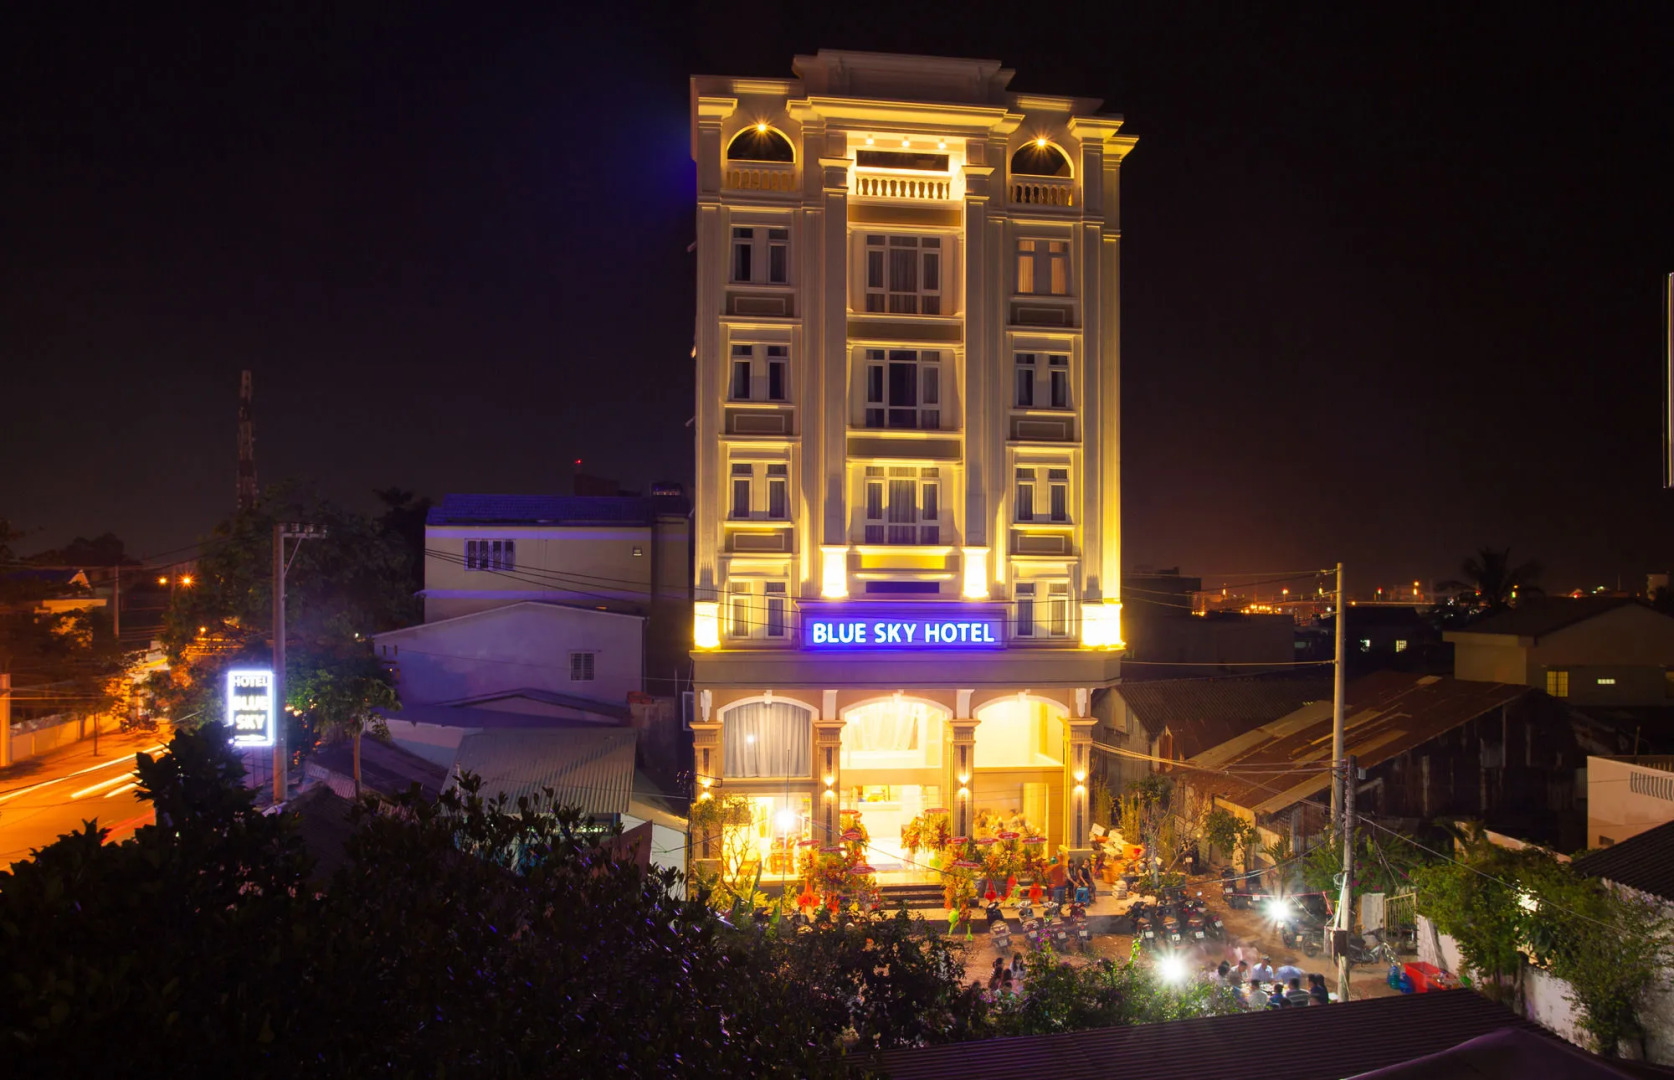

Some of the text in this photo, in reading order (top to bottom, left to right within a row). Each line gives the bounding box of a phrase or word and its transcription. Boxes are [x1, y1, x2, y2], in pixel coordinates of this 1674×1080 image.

[813, 623, 994, 643] BLUE SKY HOTEL
[233, 676, 268, 687] HOTEL
[232, 695, 269, 710] BLUE
[236, 714, 265, 729] SKY
